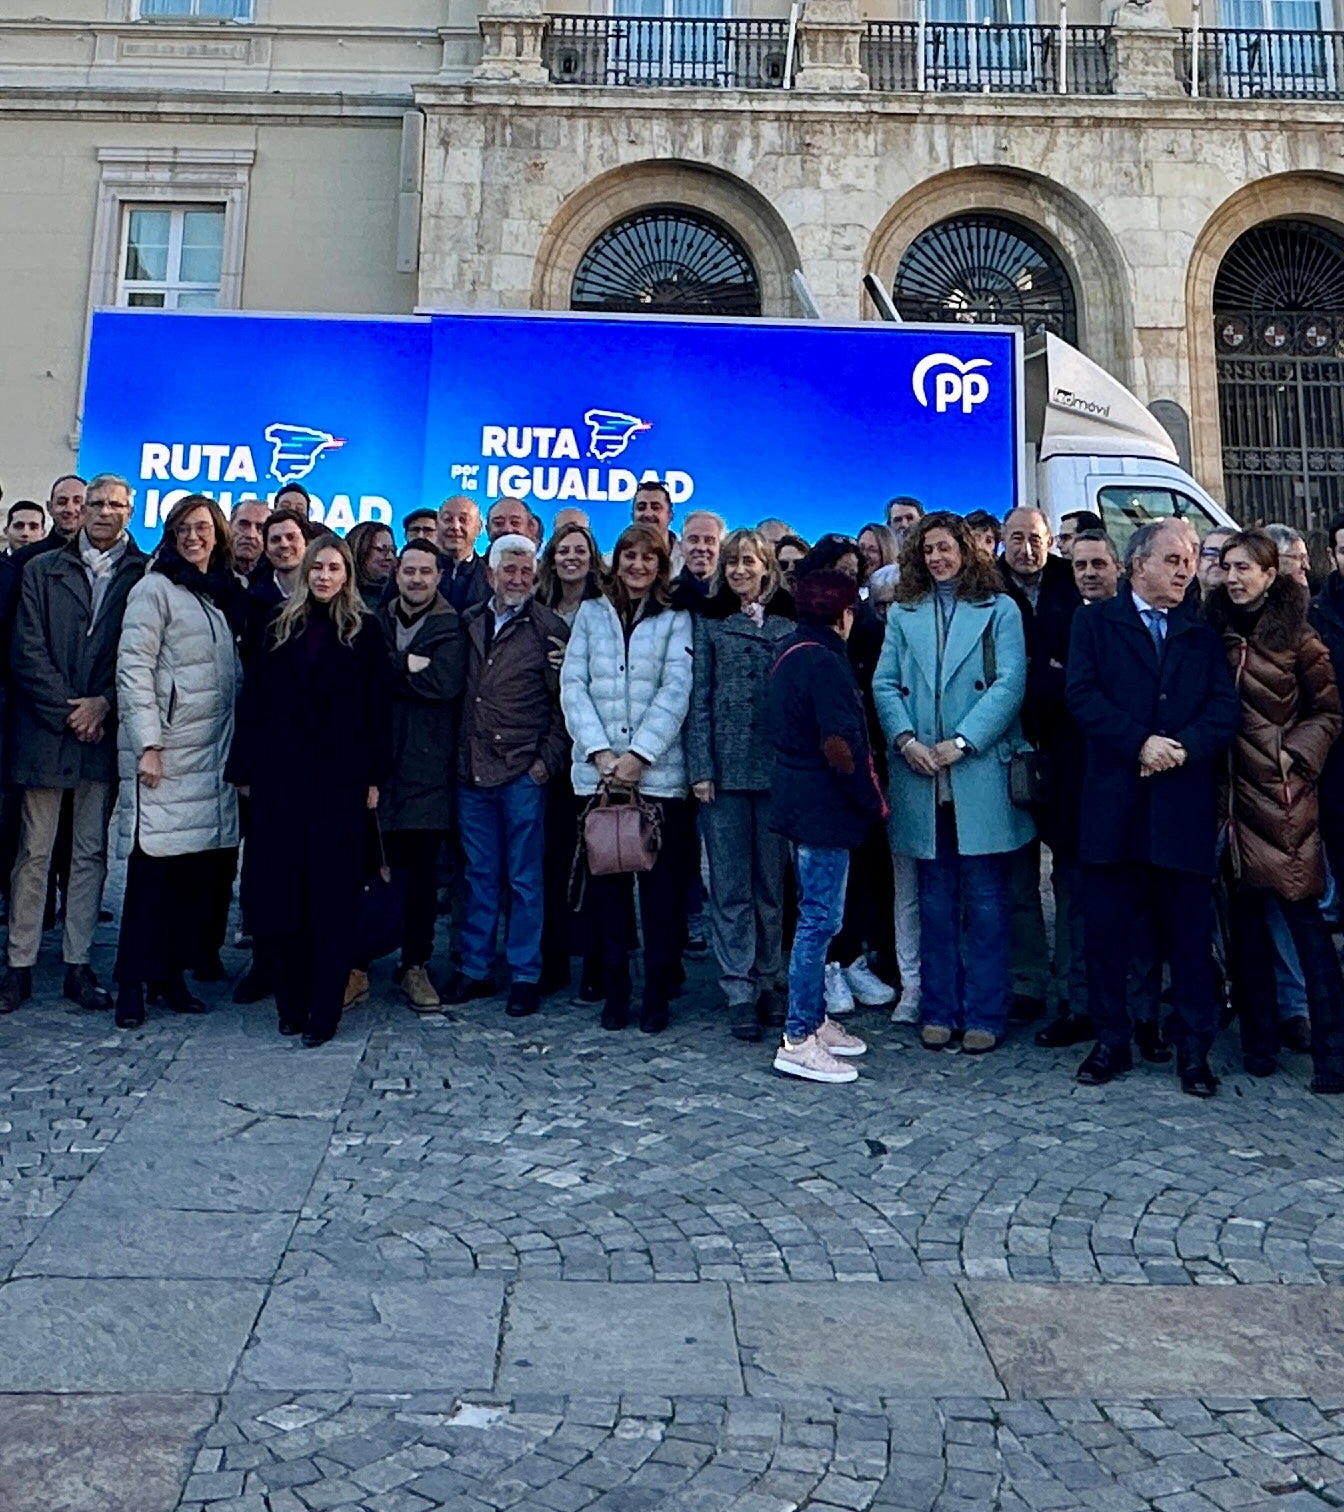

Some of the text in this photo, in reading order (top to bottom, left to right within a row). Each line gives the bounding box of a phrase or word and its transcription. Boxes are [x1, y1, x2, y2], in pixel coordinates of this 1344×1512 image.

[482, 426, 580, 460] RUTA
[140, 443, 258, 482] RUTA
[451, 464, 480, 479] por
[461, 475, 478, 491] la
